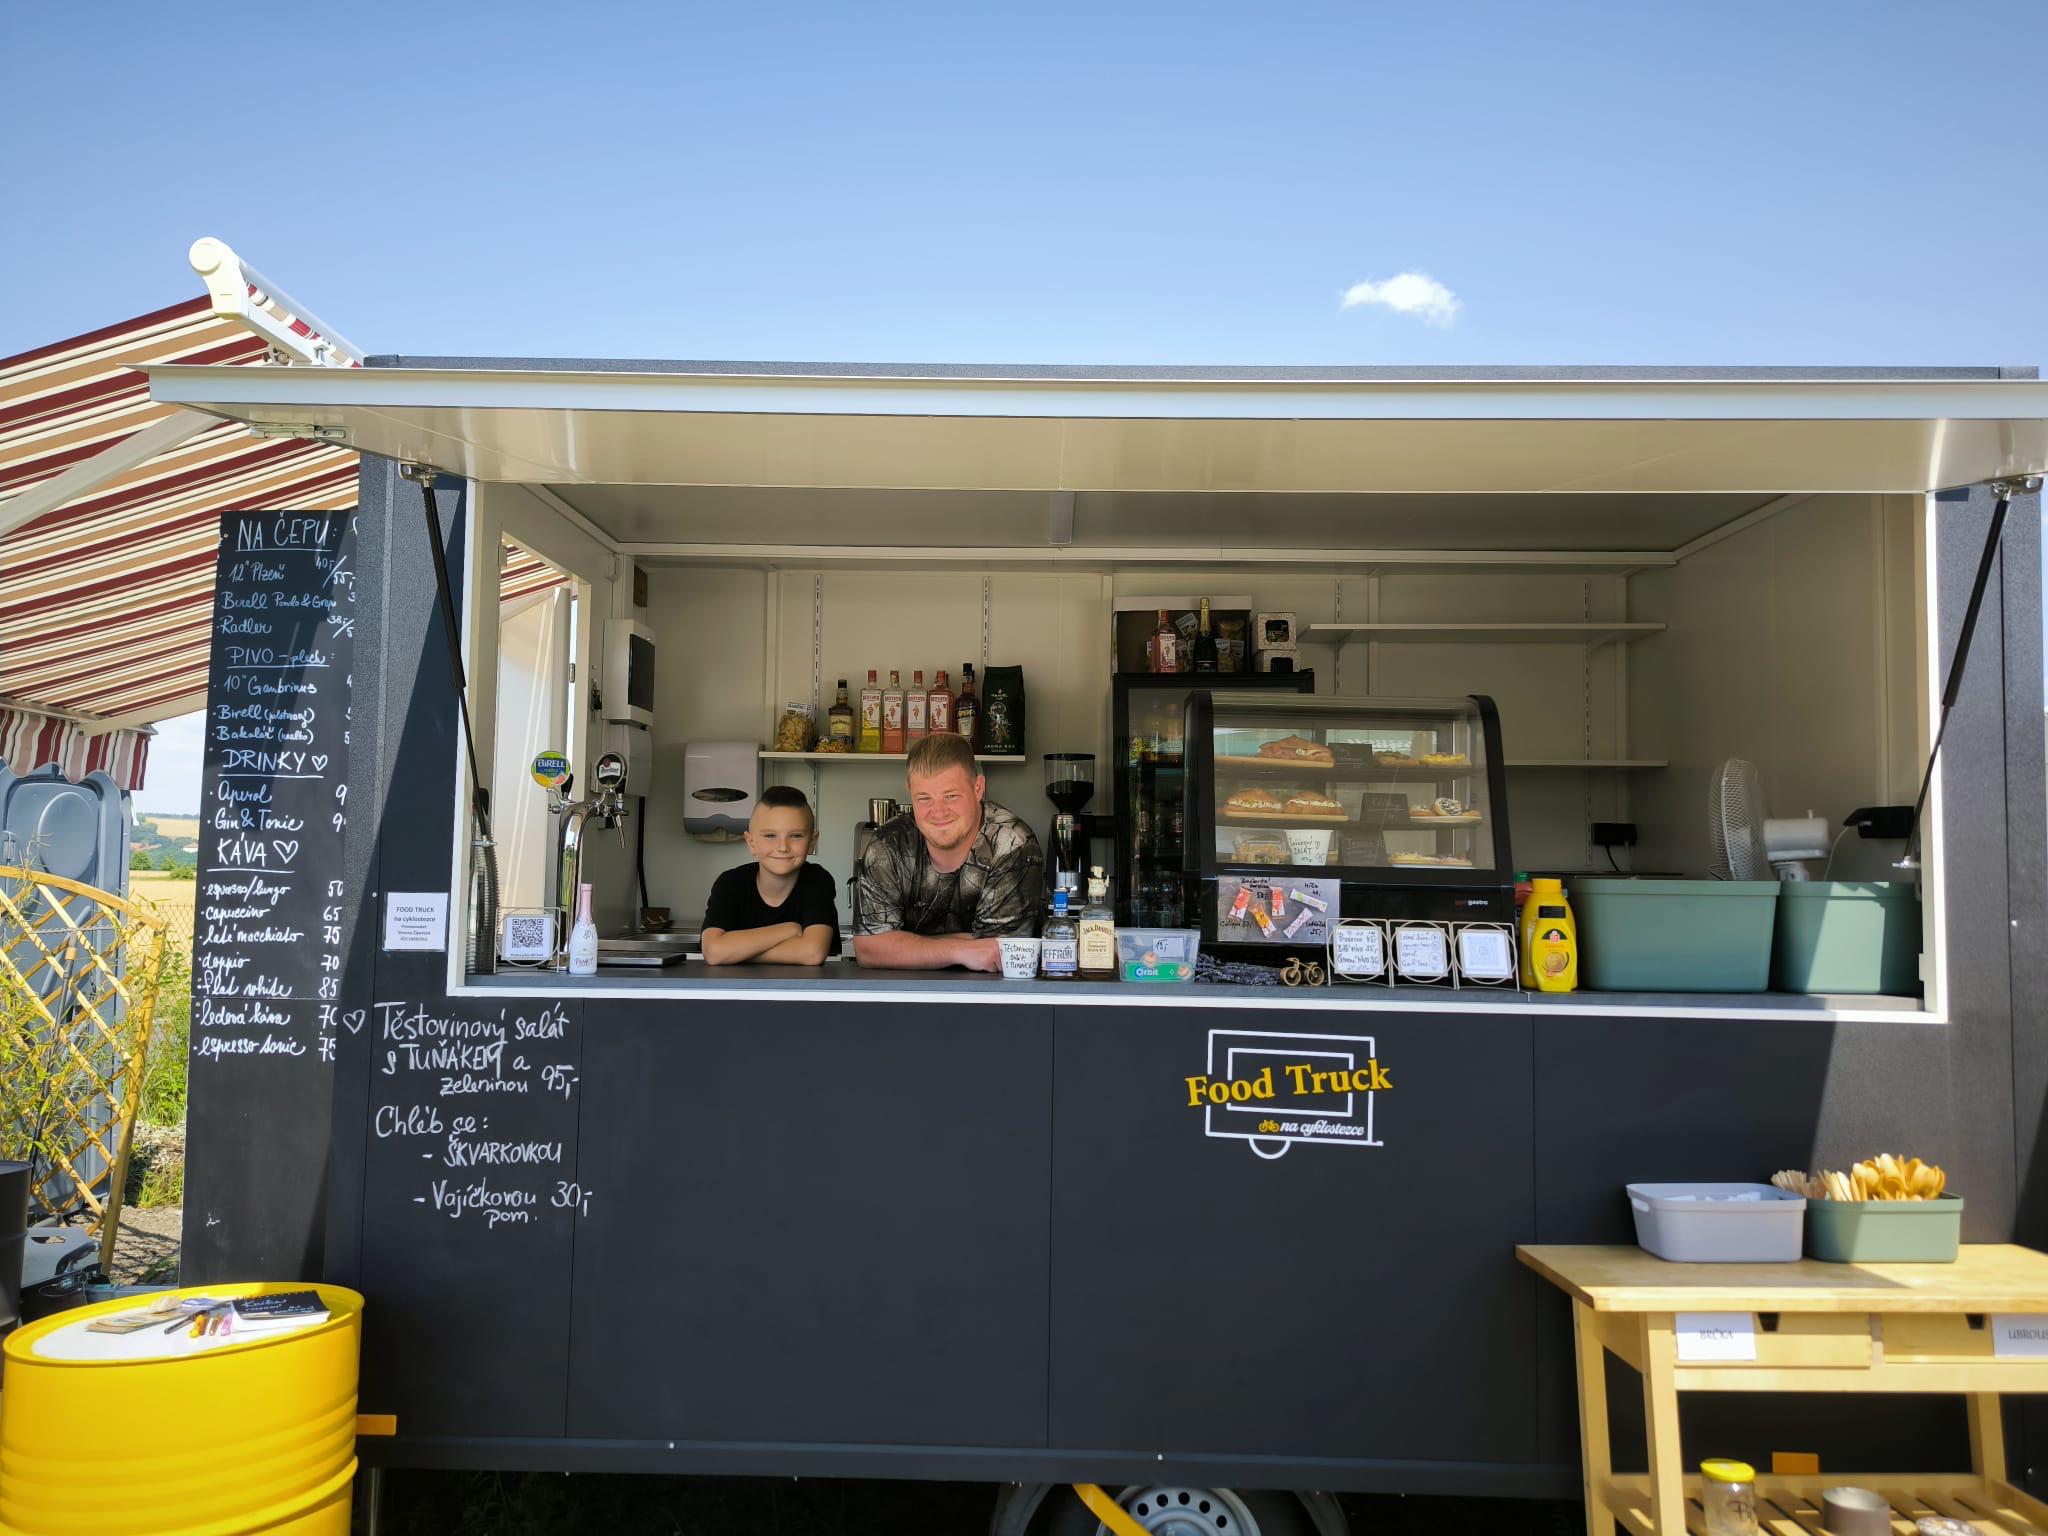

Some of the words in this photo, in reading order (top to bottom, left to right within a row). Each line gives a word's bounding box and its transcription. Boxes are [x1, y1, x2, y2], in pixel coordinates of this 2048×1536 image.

[238, 519, 263, 551] NA
[219, 615, 272, 634] Radler
[224, 646, 273, 665] PIVO
[247, 675, 318, 695] Gambrinus
[217, 704, 262, 720] Birell
[221, 749, 306, 773] DRINKY
[218, 780, 273, 809] Aperol
[215, 811, 239, 830] Gin
[258, 810, 304, 831] Tonic
[217, 832, 267, 867] KÁVA
[323, 906, 342, 921] 65
[323, 926, 342, 944] 75
[202, 952, 252, 977] doppio
[321, 955, 340, 972] 70
[202, 970, 240, 997] flat
[244, 976, 292, 997] white
[374, 1001, 507, 1044] Těstovinový
[515, 1002, 570, 1040] salát
[200, 1036, 260, 1063] espresso
[382, 1051, 397, 1075] s
[513, 1055, 530, 1071] a
[440, 1074, 528, 1096] zeleninou
[1186, 1066, 1275, 1107] Food
[1285, 1059, 1393, 1095] Truck
[375, 1105, 443, 1138] Chléb
[1280, 1120, 1299, 1132] na
[1300, 1119, 1365, 1137] cyklostezce
[432, 1177, 537, 1218] Vajíčkovou
